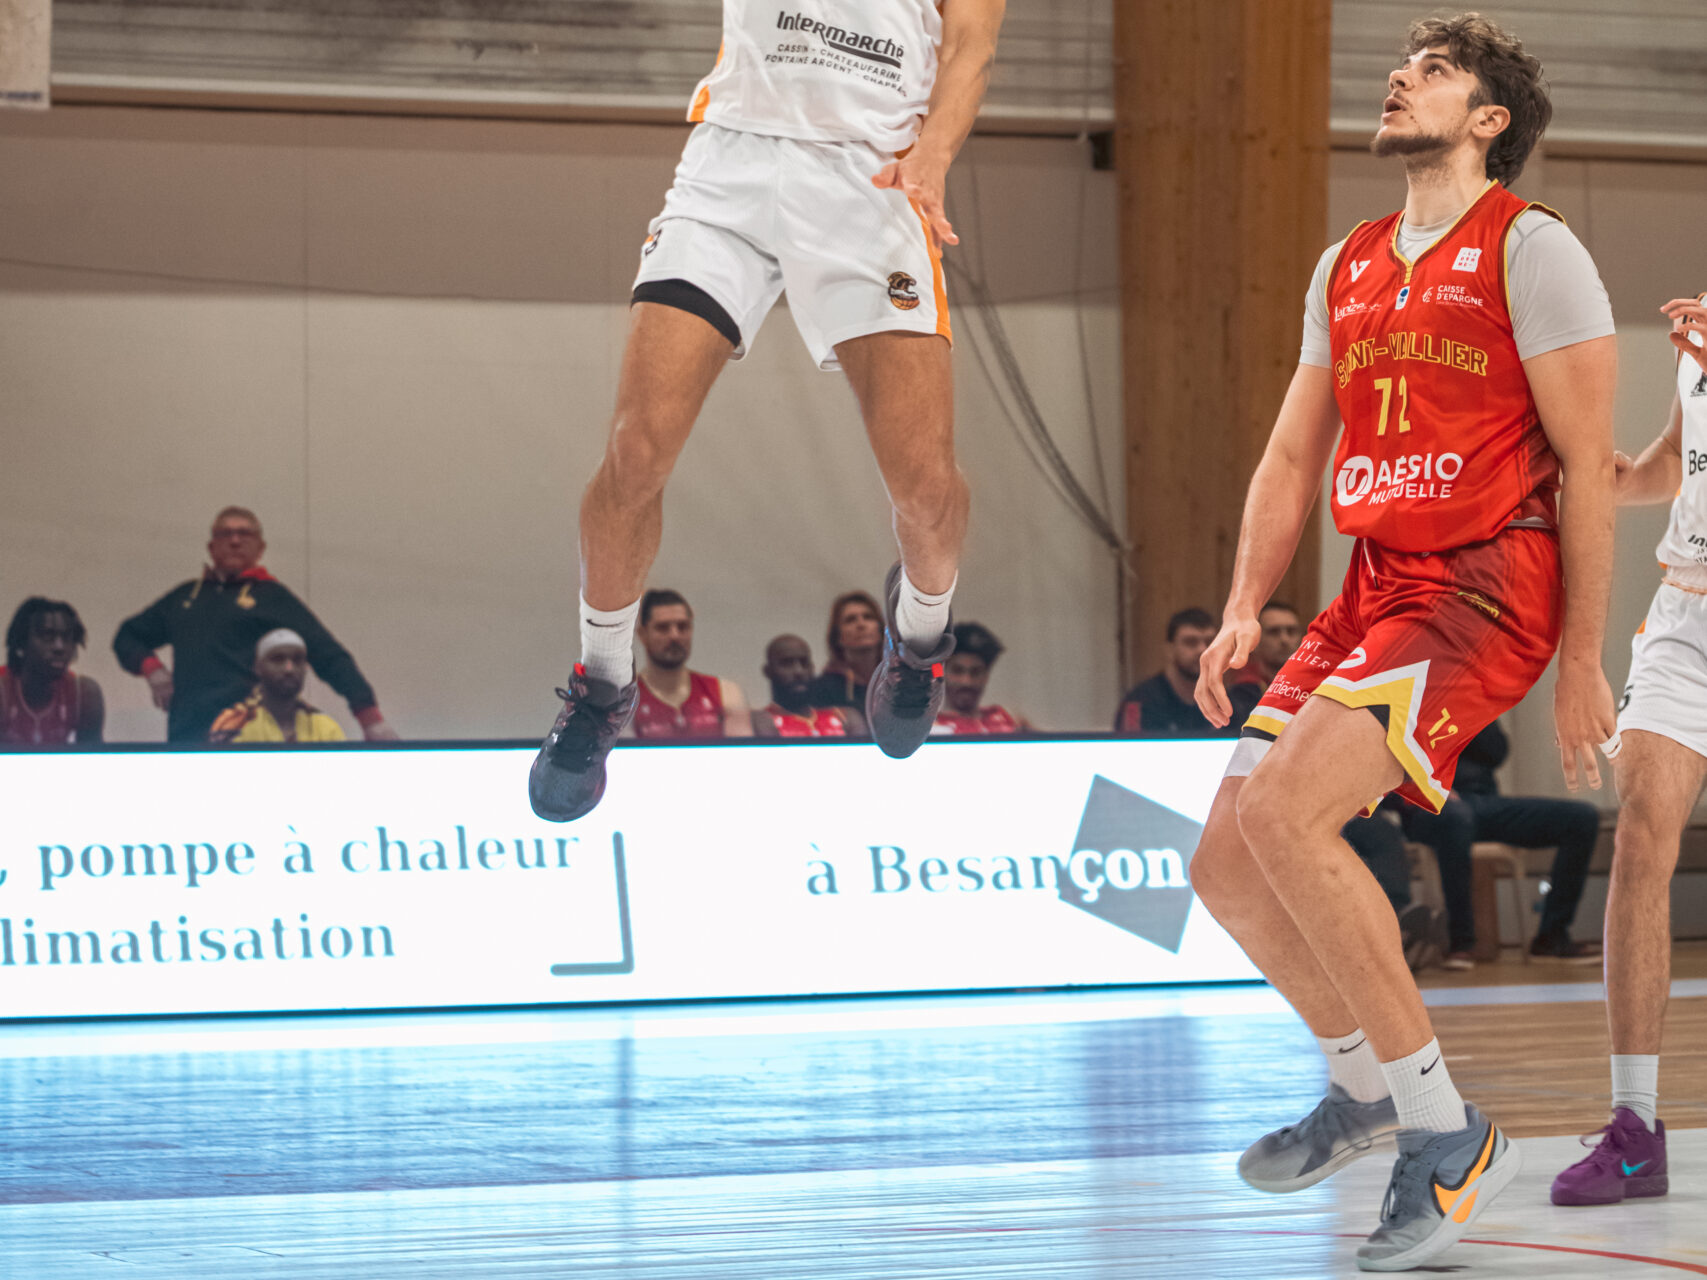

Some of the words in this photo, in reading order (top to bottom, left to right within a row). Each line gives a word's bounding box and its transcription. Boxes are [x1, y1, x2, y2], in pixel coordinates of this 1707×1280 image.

[811, 58, 852, 75] ARGENT
[1438, 285, 1466, 295] CAISSE
[1374, 375, 1411, 436] 72
[1368, 482, 1453, 506] MUTUELLE
[38, 842, 257, 891] pompe
[283, 825, 315, 874] à
[340, 825, 580, 872] chaleur
[806, 842, 840, 895] à
[866, 844, 1189, 903] Besançon
[0, 913, 397, 967] limatisation
